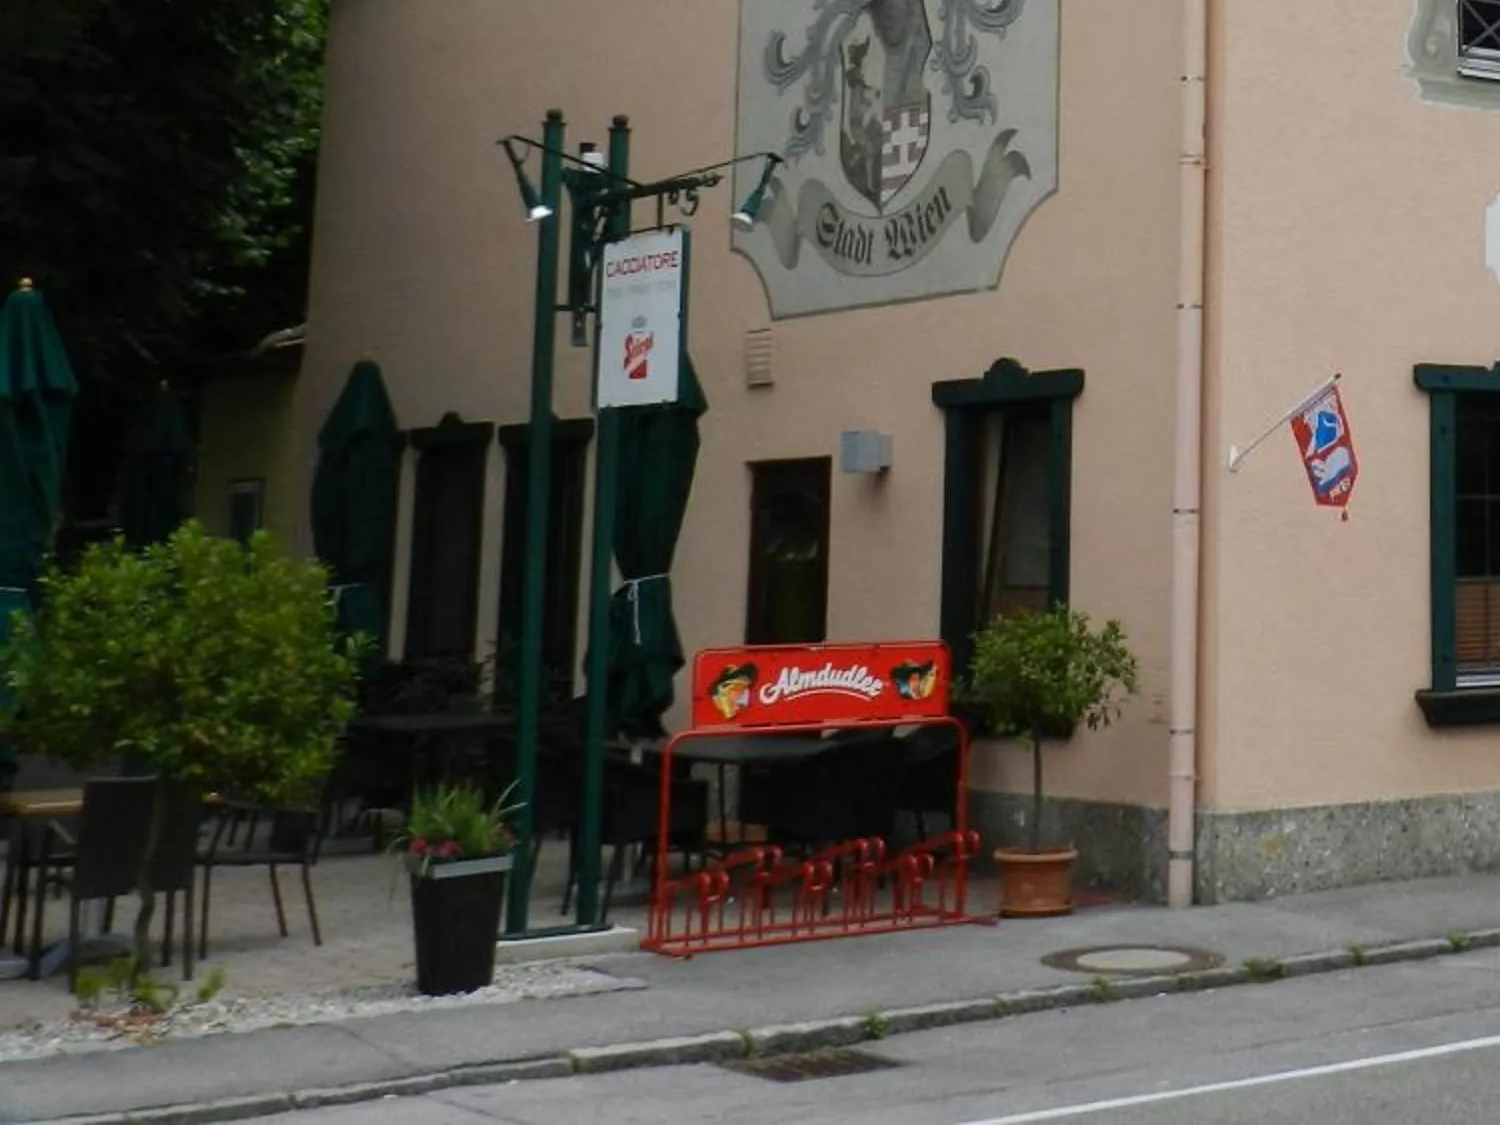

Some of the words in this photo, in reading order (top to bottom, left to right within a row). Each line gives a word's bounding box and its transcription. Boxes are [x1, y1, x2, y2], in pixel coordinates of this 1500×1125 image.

[816, 202, 873, 265] Stadt
[885, 186, 952, 260] Wien
[607, 251, 678, 278] CACCIATORE
[760, 662, 883, 704] Almdudler
